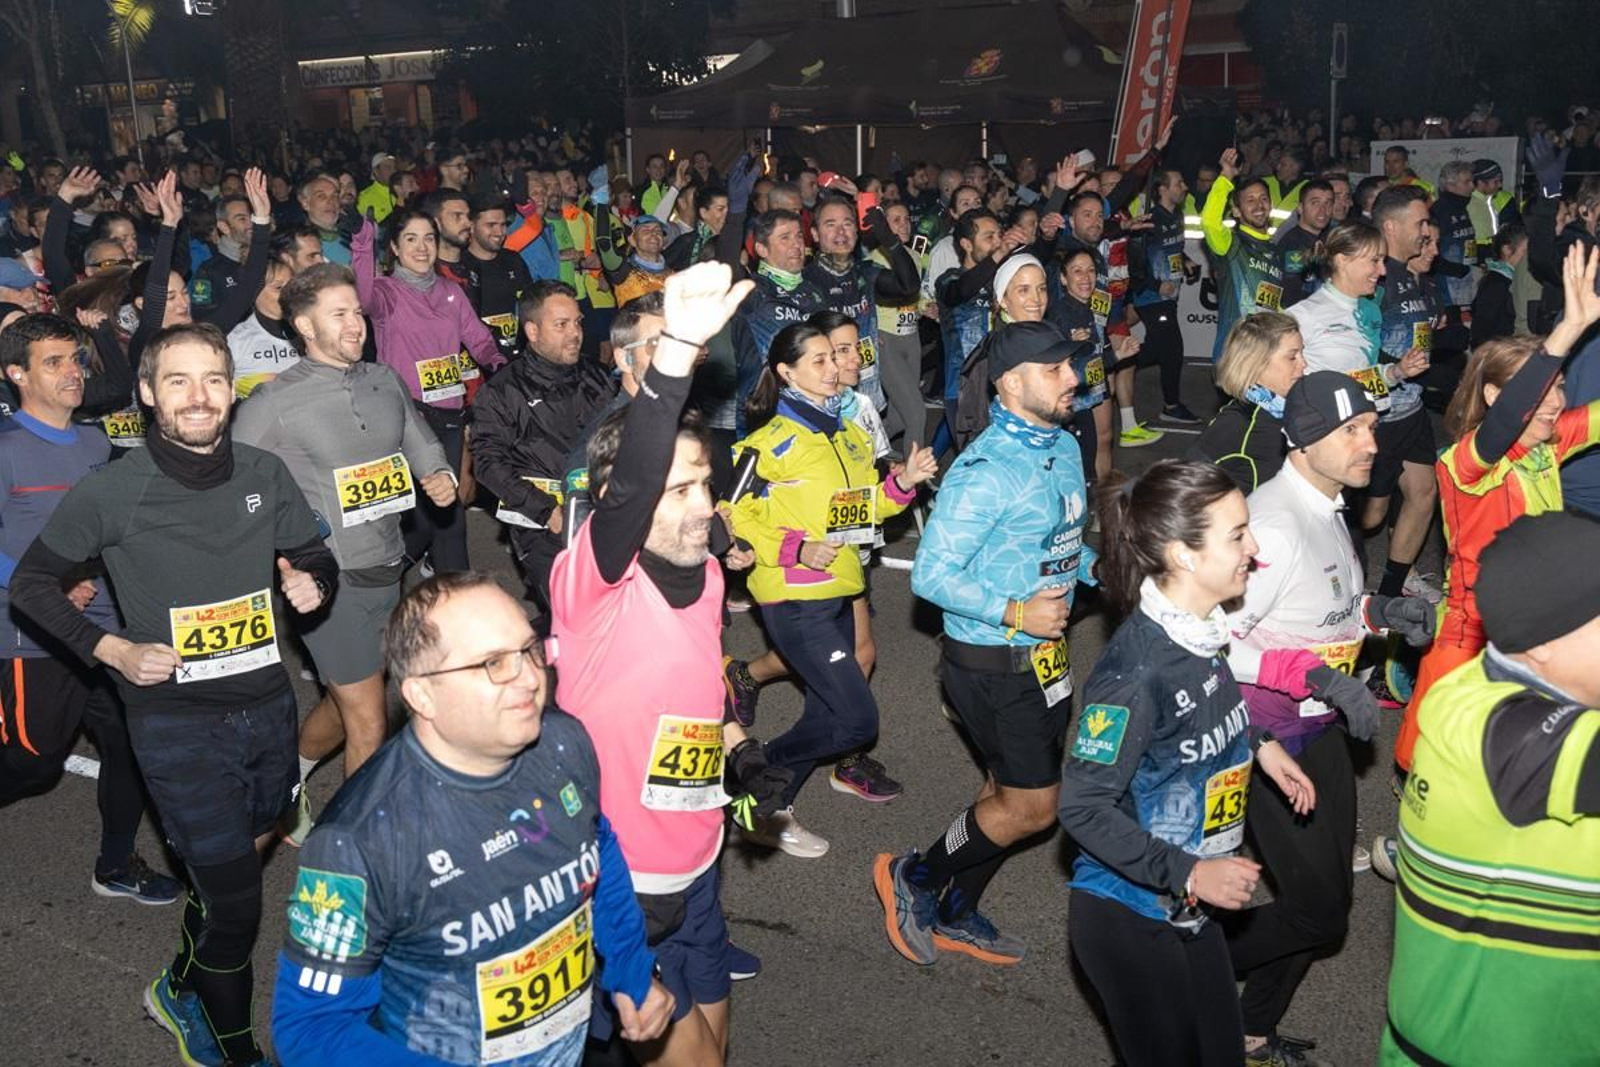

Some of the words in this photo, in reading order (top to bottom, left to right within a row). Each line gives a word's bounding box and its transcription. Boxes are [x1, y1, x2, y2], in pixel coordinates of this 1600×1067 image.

[424, 366, 460, 387] 3840
[345, 471, 407, 505] 3943
[829, 503, 869, 526] 3996
[195, 607, 216, 622] 42
[182, 614, 268, 653] 4376
[657, 744, 724, 777] 4378
[1179, 728, 1226, 764] SAN
[441, 895, 517, 957] SAN
[513, 951, 537, 975] 42
[495, 938, 588, 1023] 3917
